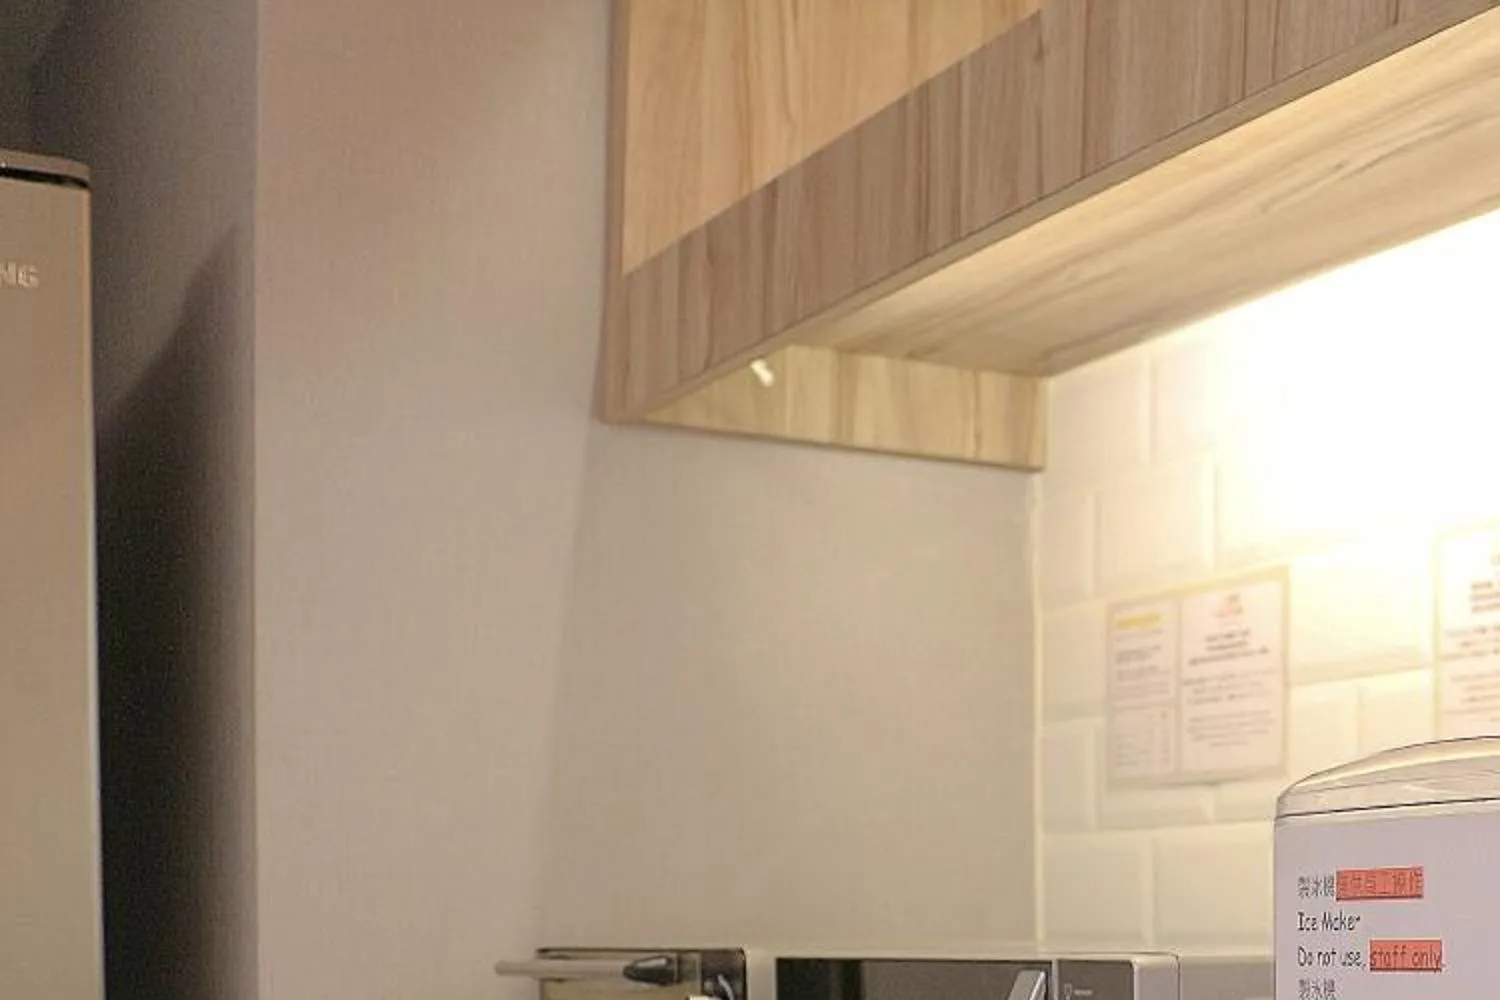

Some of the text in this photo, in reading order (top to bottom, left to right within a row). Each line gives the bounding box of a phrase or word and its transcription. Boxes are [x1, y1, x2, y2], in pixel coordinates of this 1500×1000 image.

[1298, 910, 1361, 931] Ice Maker
[1298, 946, 1313, 967] Do
[1318, 948, 1337, 967] not
[1369, 944, 1407, 968] staff
